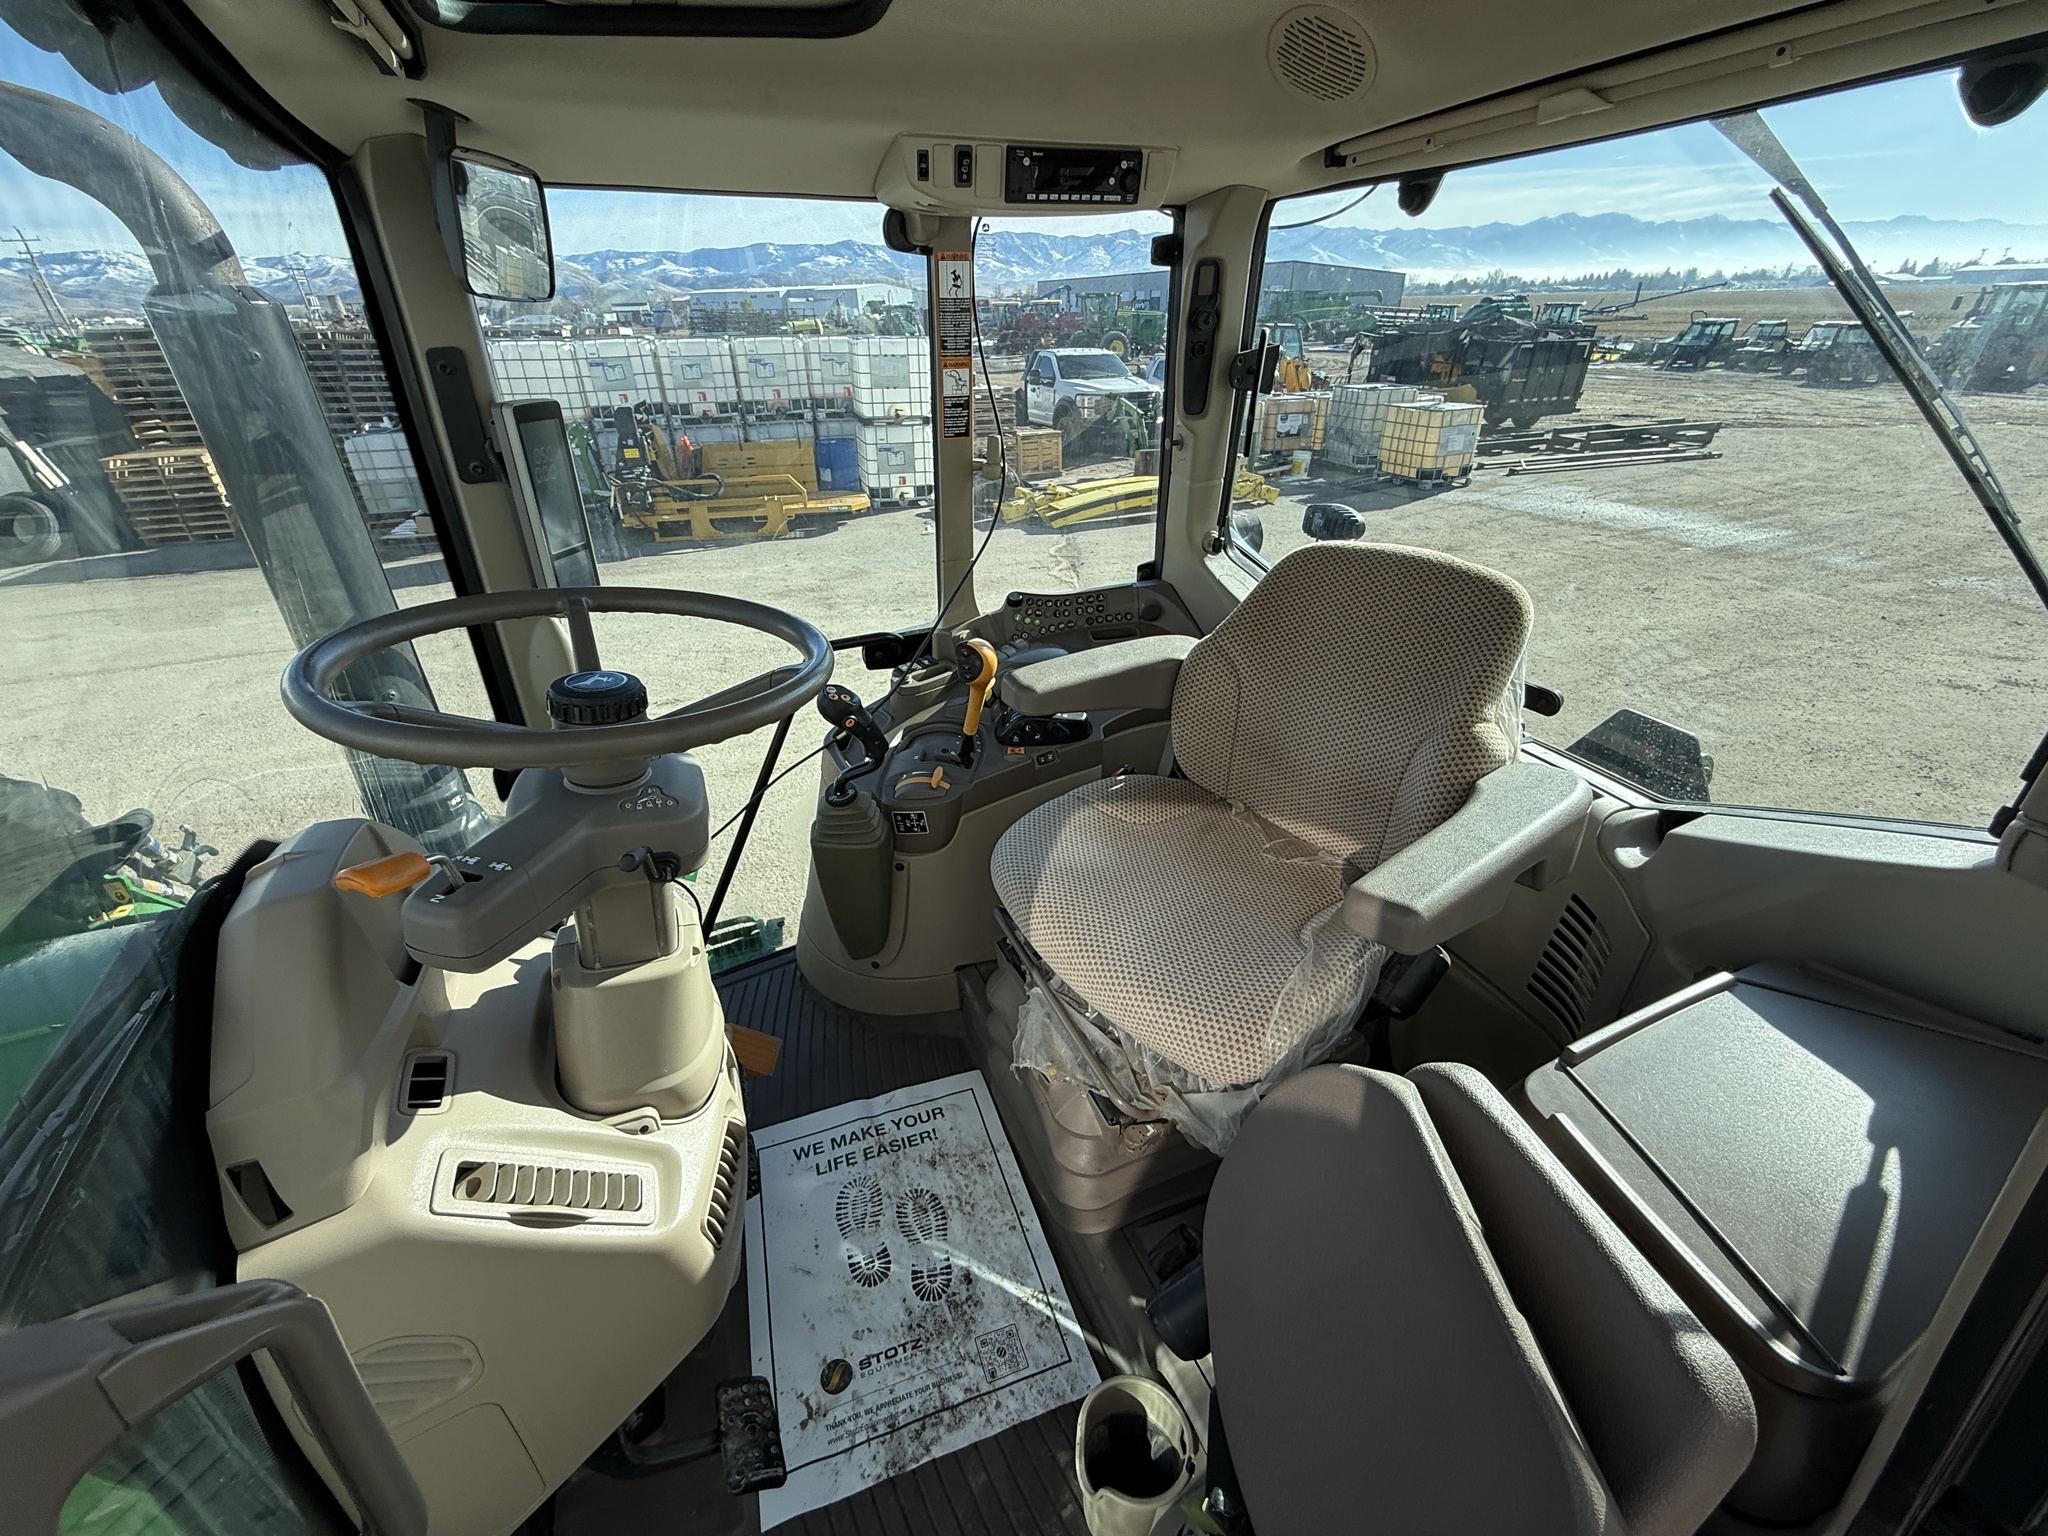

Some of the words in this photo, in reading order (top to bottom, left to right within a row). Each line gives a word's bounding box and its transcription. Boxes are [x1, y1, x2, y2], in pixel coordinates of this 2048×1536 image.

[793, 1141, 825, 1161] WE
[830, 1123, 887, 1150] MAKE
[890, 1107, 945, 1131] YOUR
[815, 1151, 858, 1176] LIFE
[863, 1128, 938, 1161] EASIER!
[858, 1338, 923, 1371] STOTZ
[860, 1350, 926, 1379] EQUIPMENT
[825, 1415, 848, 1432] THANK
[863, 1407, 874, 1417] WE
[875, 1392, 913, 1413] APPRECIATE
[914, 1384, 931, 1397] YOUR
